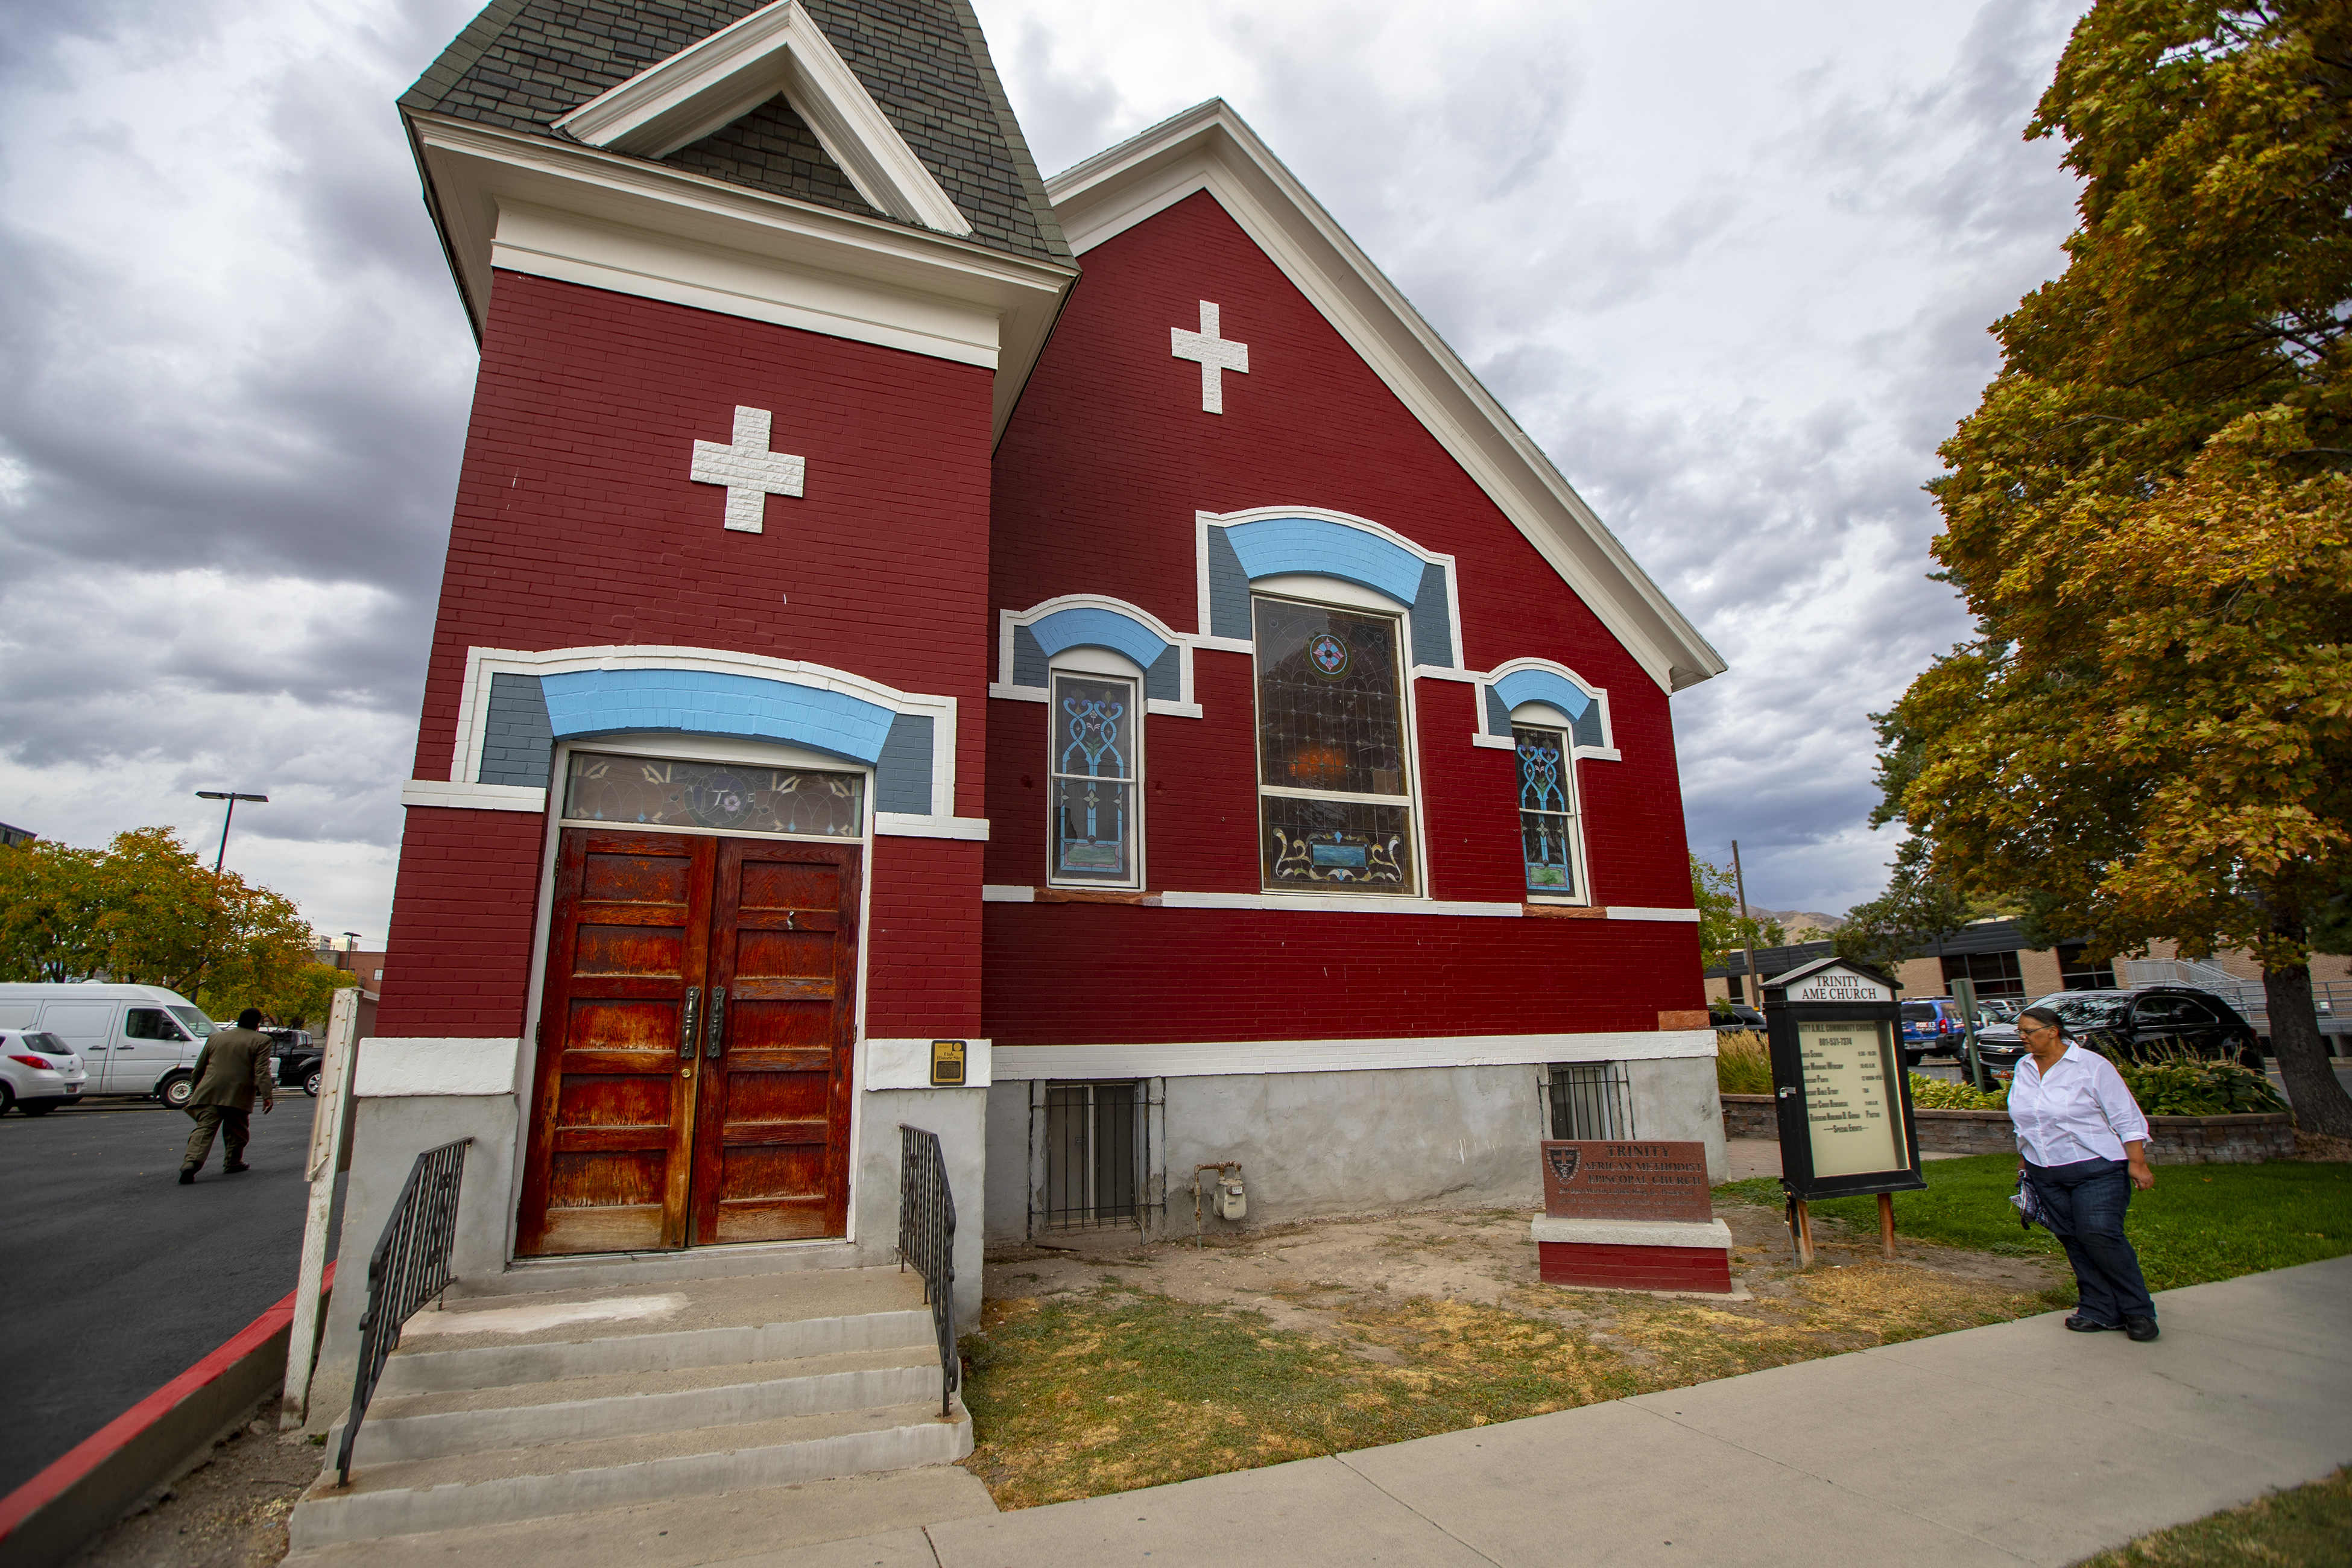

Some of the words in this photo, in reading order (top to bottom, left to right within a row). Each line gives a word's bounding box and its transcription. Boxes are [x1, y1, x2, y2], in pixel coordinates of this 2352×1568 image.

[1815, 976, 1859, 987] TRINITY
[1801, 988, 1827, 999] AME
[1829, 988, 1877, 999] CHURCH
[1606, 1145, 1669, 1157] TRINITY
[1584, 1162, 1631, 1171] AFRICAN
[1636, 1162, 1702, 1172] METHODIST
[1588, 1175, 1648, 1184] EPISCOPAL
[1652, 1175, 1701, 1186] CHURCH
